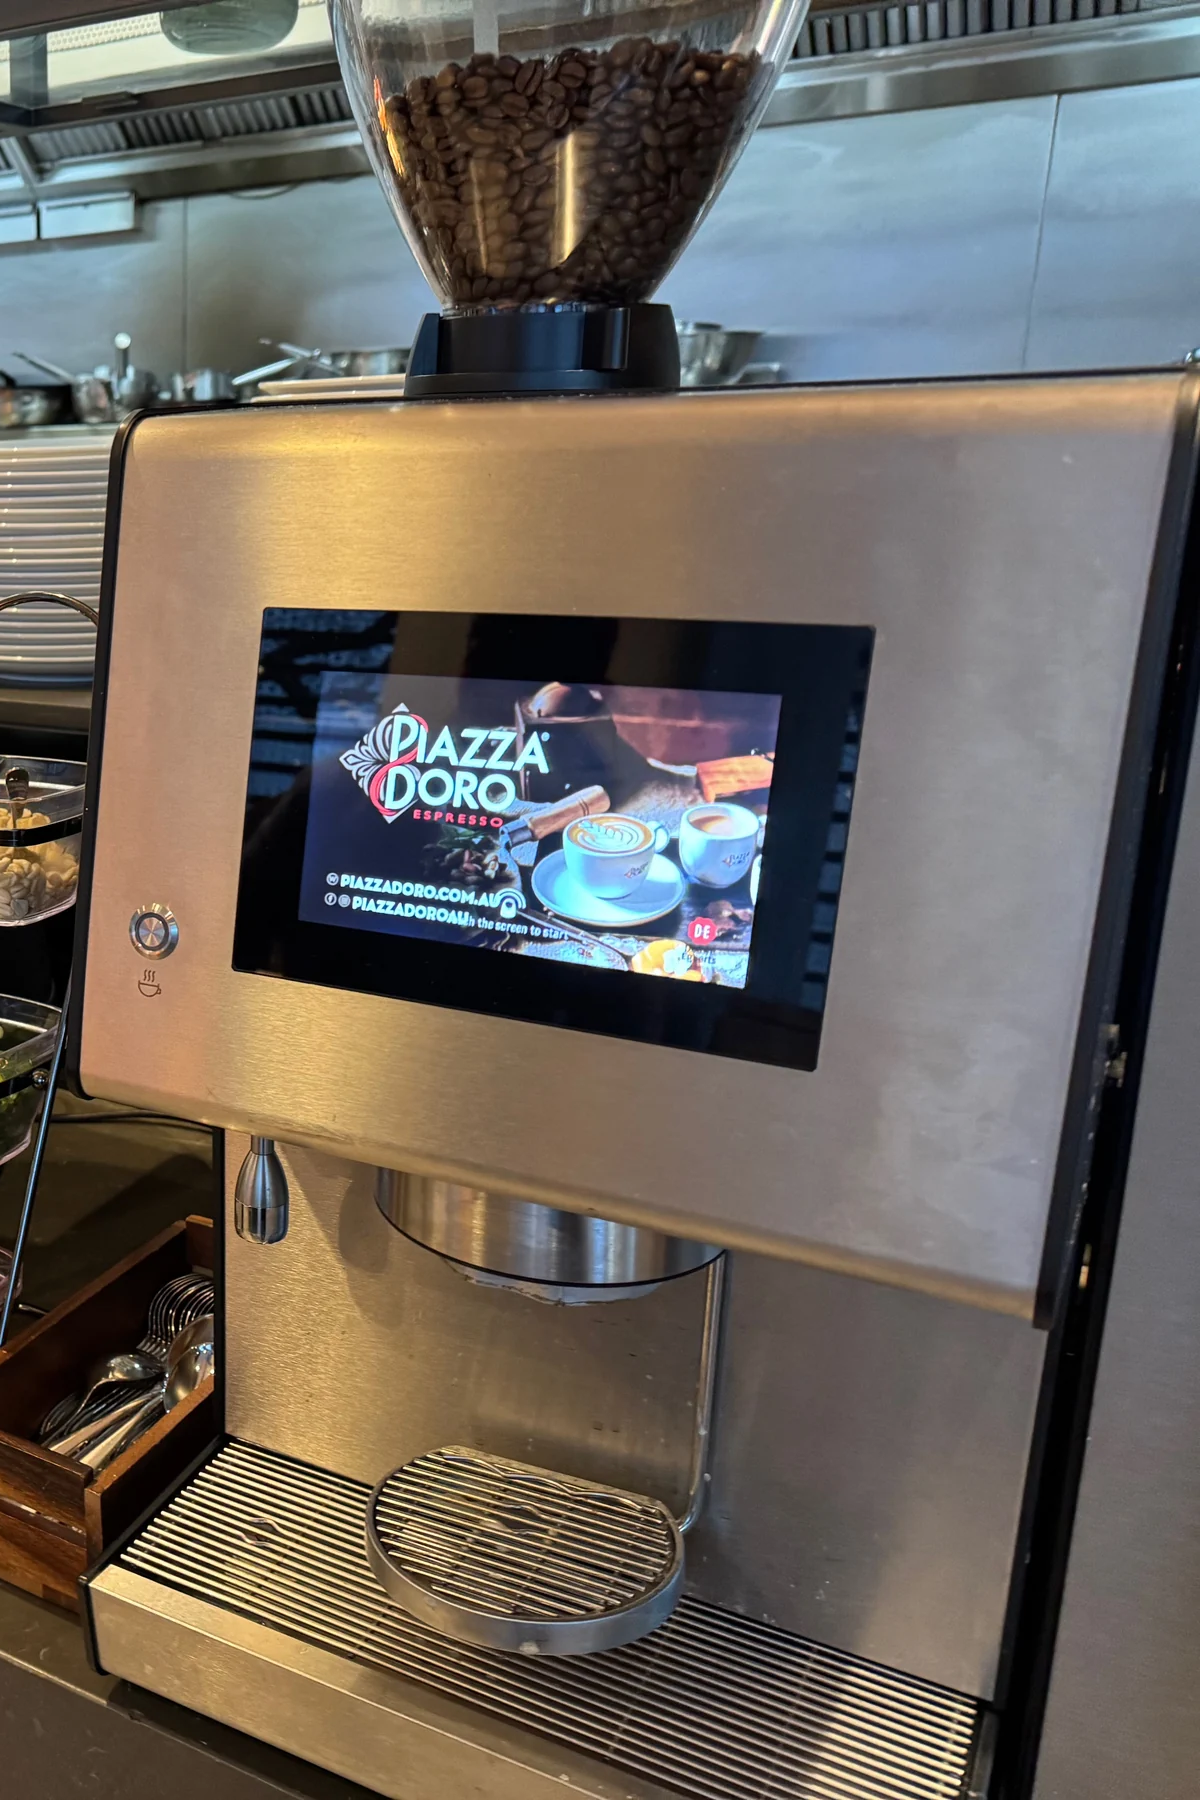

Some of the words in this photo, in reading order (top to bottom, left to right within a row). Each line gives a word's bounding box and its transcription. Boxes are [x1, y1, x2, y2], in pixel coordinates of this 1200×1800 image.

[389, 714, 550, 774] PIAZZA
[413, 809, 504, 828] ESPRESSO
[340, 873, 500, 908] PIAZZADORO.COM.AU
[352, 896, 470, 926] PIAZZADOROAU
[477, 916, 494, 930] the
[495, 920, 528, 935] screen
[530, 924, 541, 937] to
[542, 925, 569, 941] start
